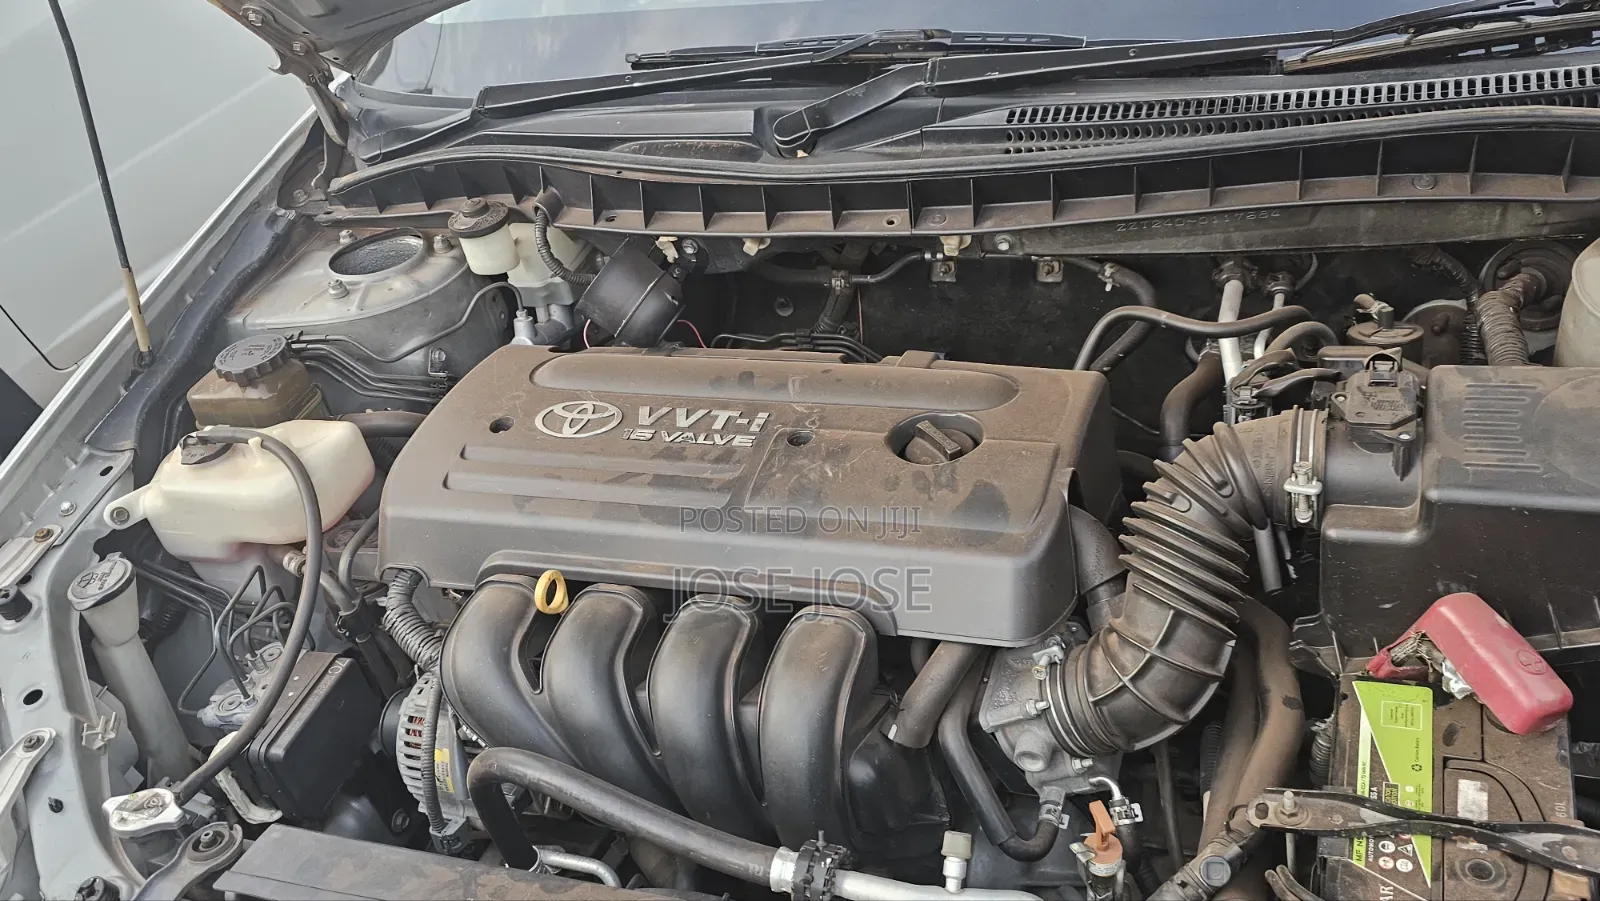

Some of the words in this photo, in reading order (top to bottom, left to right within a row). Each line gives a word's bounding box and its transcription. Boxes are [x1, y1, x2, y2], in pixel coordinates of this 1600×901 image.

[638, 405, 770, 432] VVT-i
[622, 428, 656, 441] 16
[661, 430, 756, 447] VALVE
